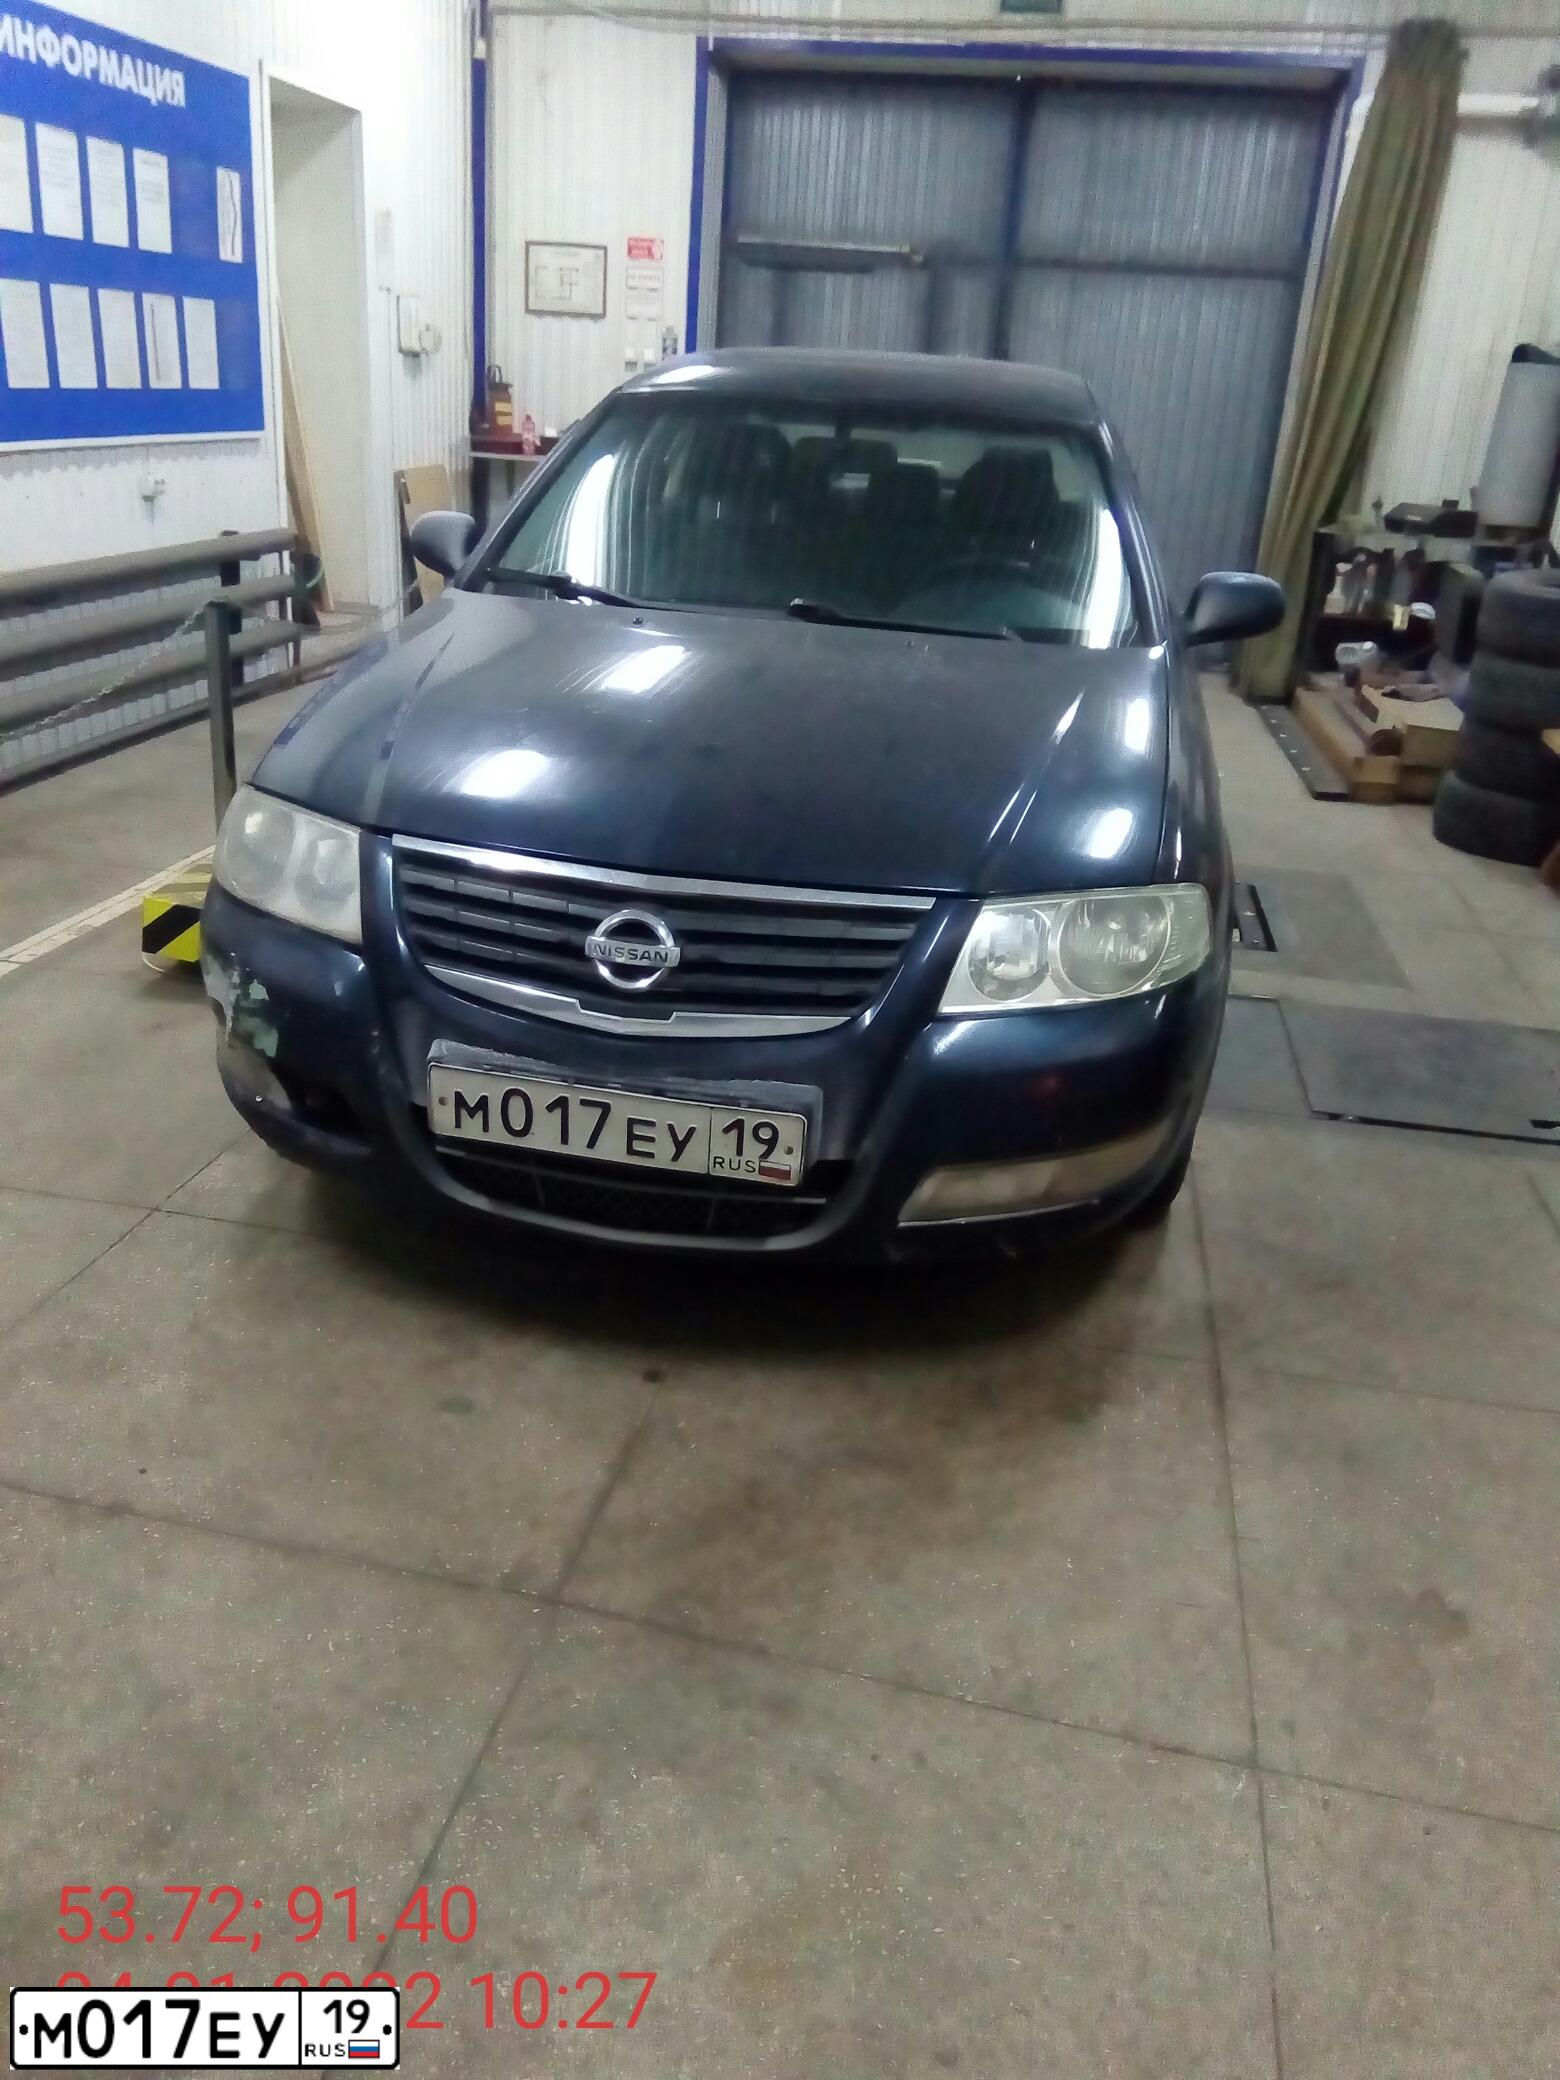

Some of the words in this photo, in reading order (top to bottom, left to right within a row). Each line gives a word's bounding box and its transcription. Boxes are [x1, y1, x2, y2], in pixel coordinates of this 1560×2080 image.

[594, 943, 669, 963] NISSAN
[721, 1118, 780, 1160] 19
[712, 1155, 757, 1174] RUS
